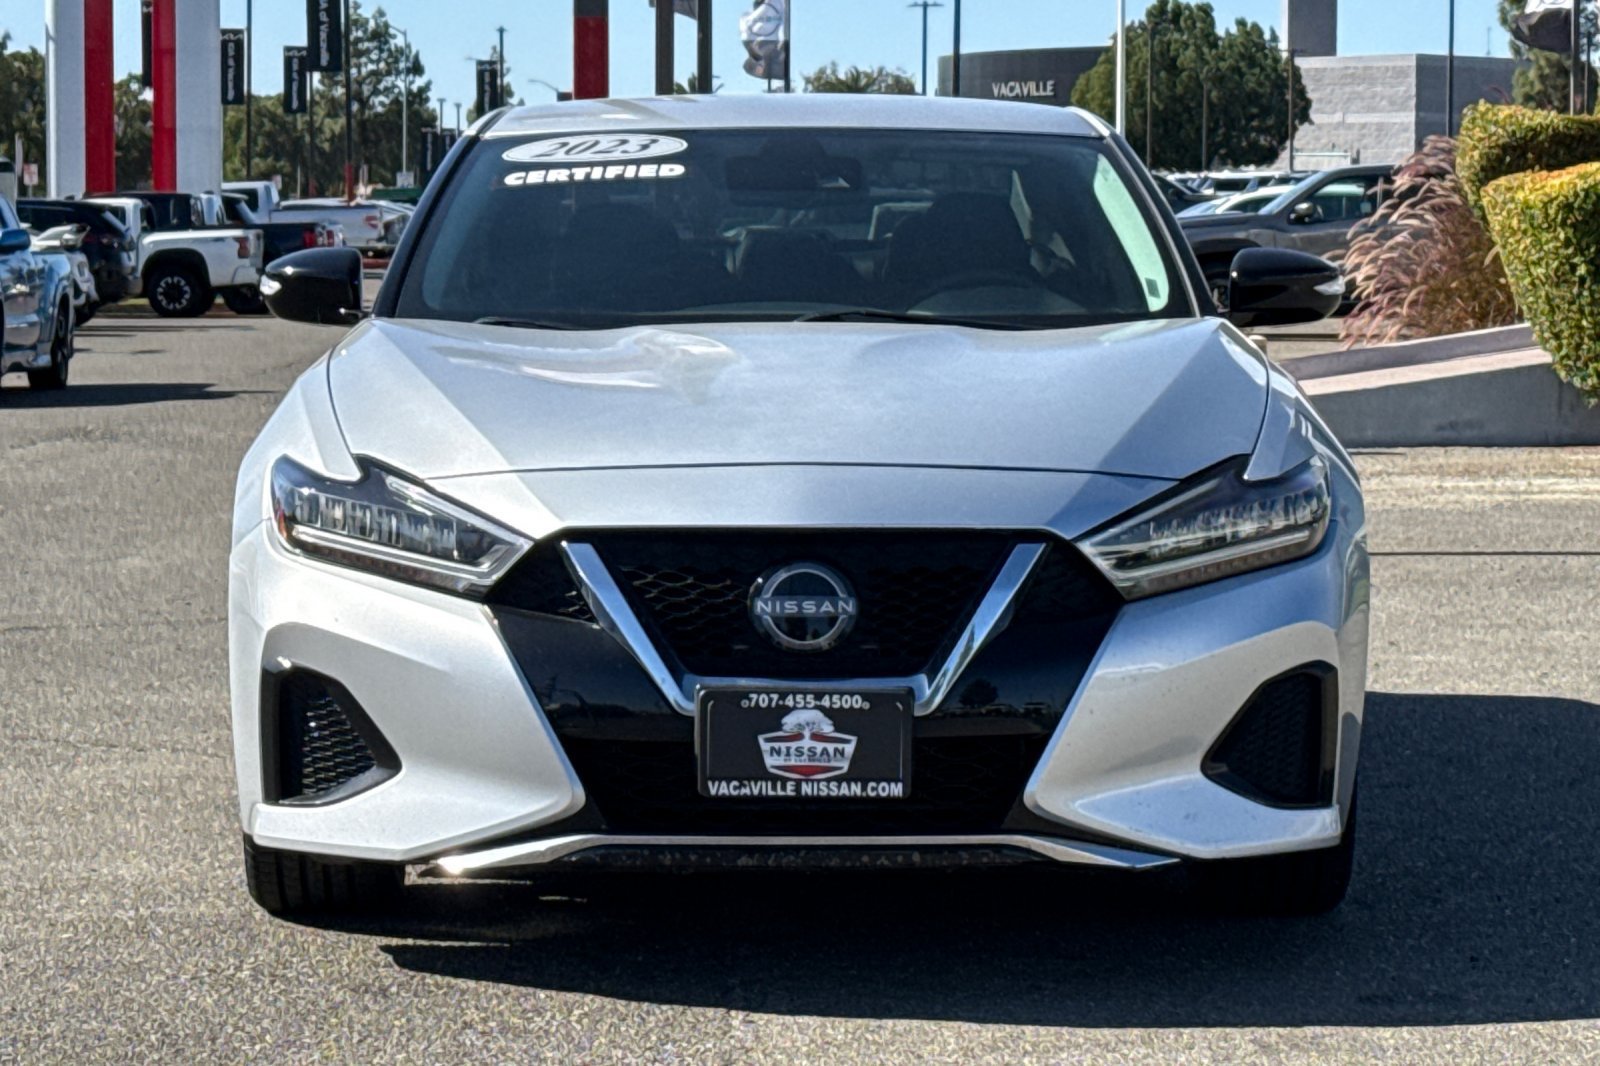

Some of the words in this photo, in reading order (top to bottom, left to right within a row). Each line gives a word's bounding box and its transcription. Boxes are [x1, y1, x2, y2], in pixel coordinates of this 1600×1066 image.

[991, 80, 1055, 98] VACAVILLE
[529, 138, 660, 158] 2023
[503, 163, 686, 186] CERTIFIED
[756, 600, 854, 614] NISSAN
[769, 745, 846, 758] NISSAN
[707, 780, 796, 796] VACAVILLE
[801, 781, 904, 798] NISSAN.COM
